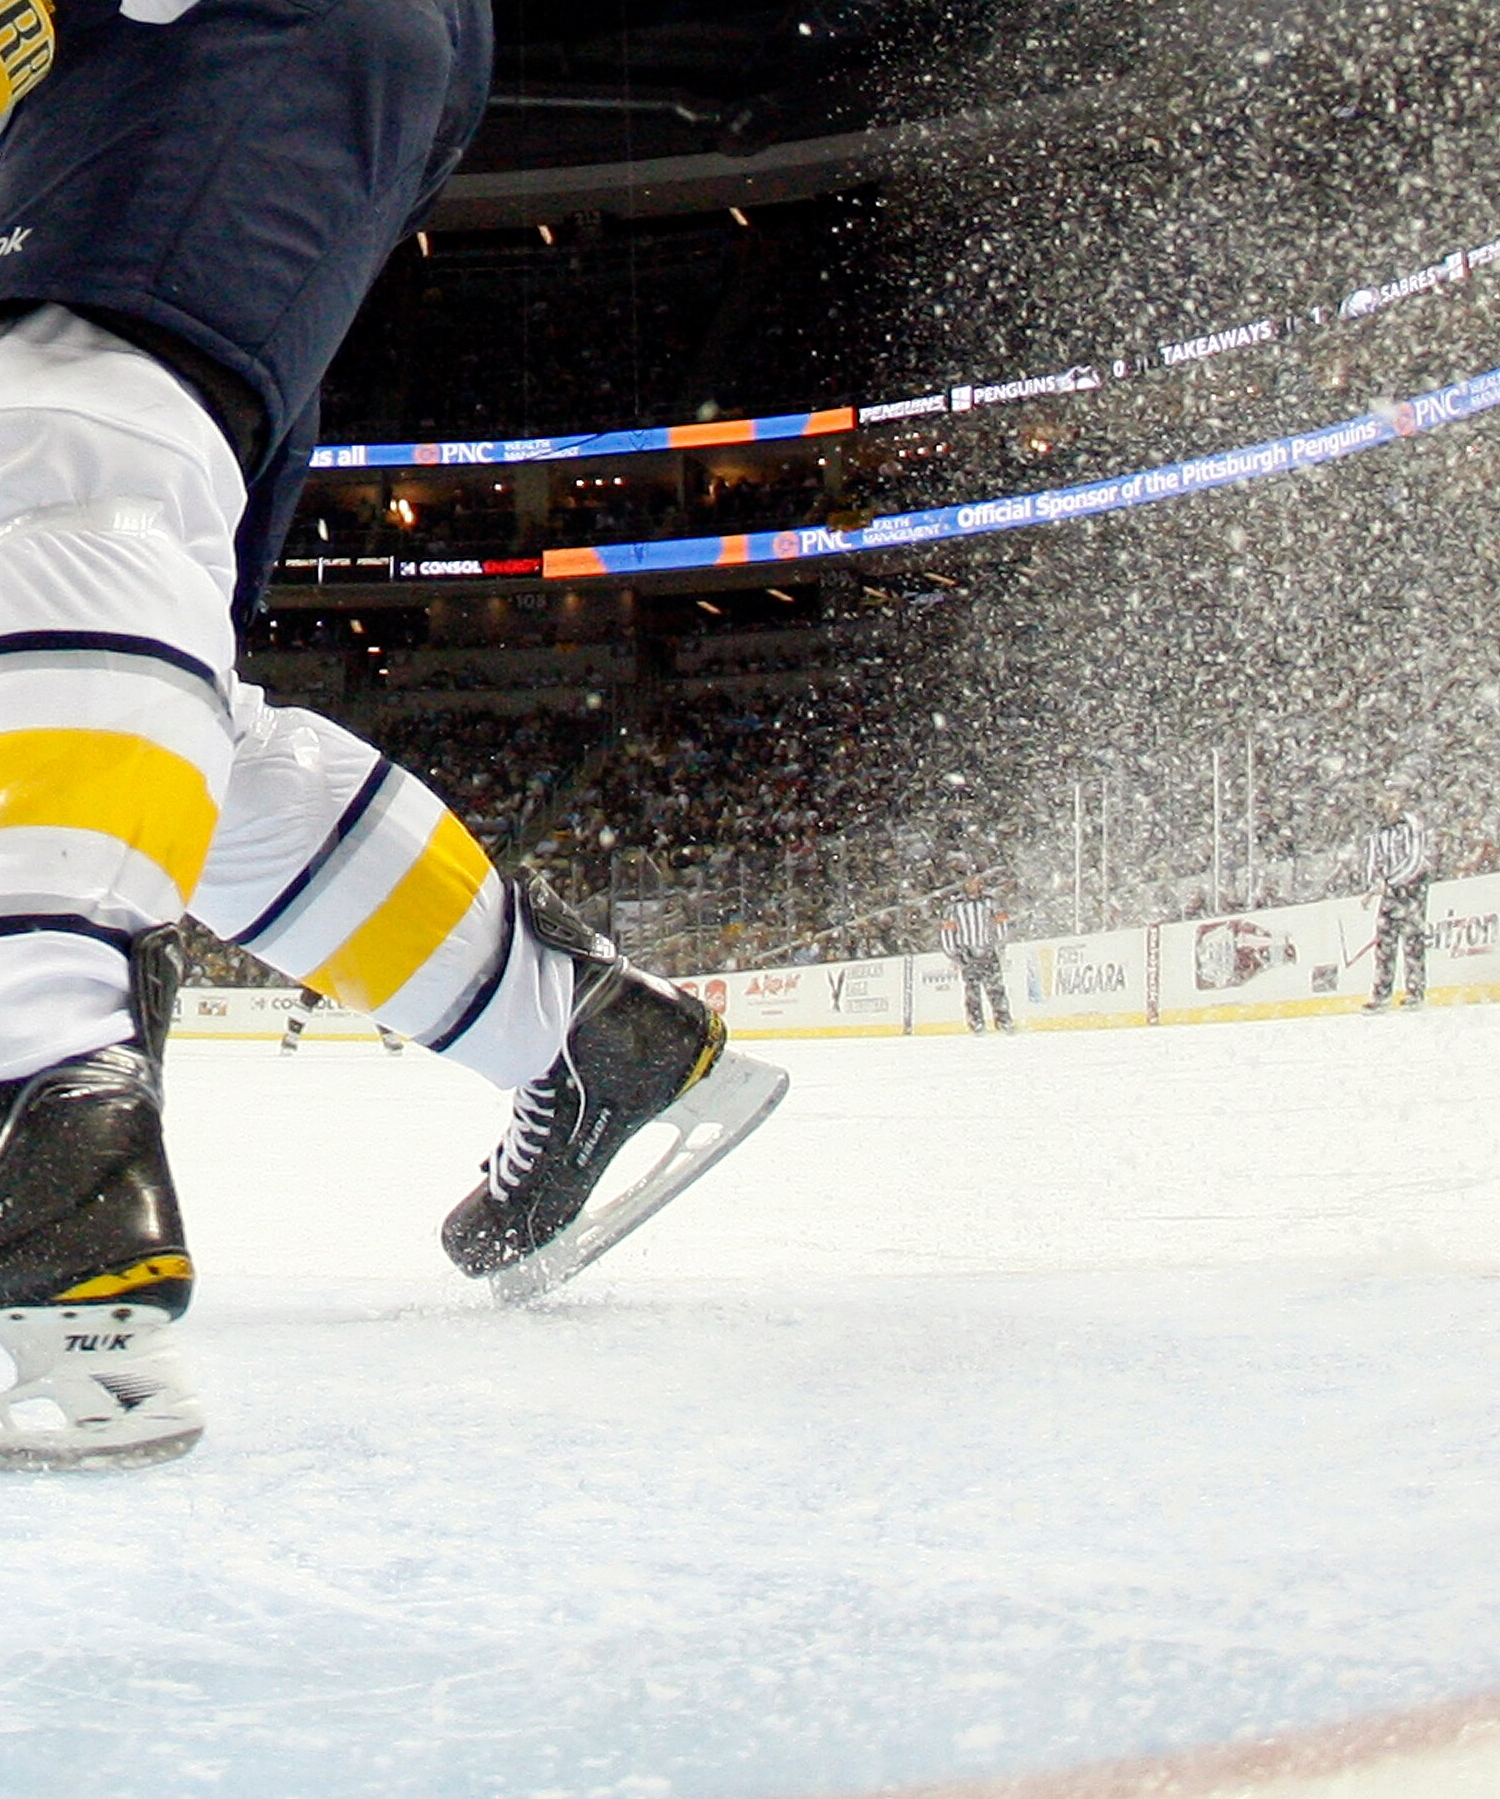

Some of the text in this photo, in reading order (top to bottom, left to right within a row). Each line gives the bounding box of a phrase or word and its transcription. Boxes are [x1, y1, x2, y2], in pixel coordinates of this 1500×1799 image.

[973, 375, 1056, 406] PENGUINS
[1113, 360, 1125, 378] 0
[1161, 319, 1272, 366] TAKEAWAYS
[1310, 306, 1321, 324] 1
[1381, 266, 1437, 303] SABRES
[338, 445, 367, 466] all
[441, 443, 495, 464] PNC
[957, 499, 1031, 528] Official
[1035, 484, 1117, 518] Sponsor
[1121, 480, 1142, 500] of
[1145, 472, 1179, 494] the
[1182, 443, 1288, 485] Pittsburgh
[1291, 420, 1378, 459] Penguins
[1415, 388, 1461, 426] PNC
[802, 531, 852, 553] PNC
[862, 523, 942, 545] MANAGEMENT
[419, 560, 483, 575] CONSOL
[1426, 909, 1498, 955] erizon
[1055, 963, 1127, 996] NIAGARA
